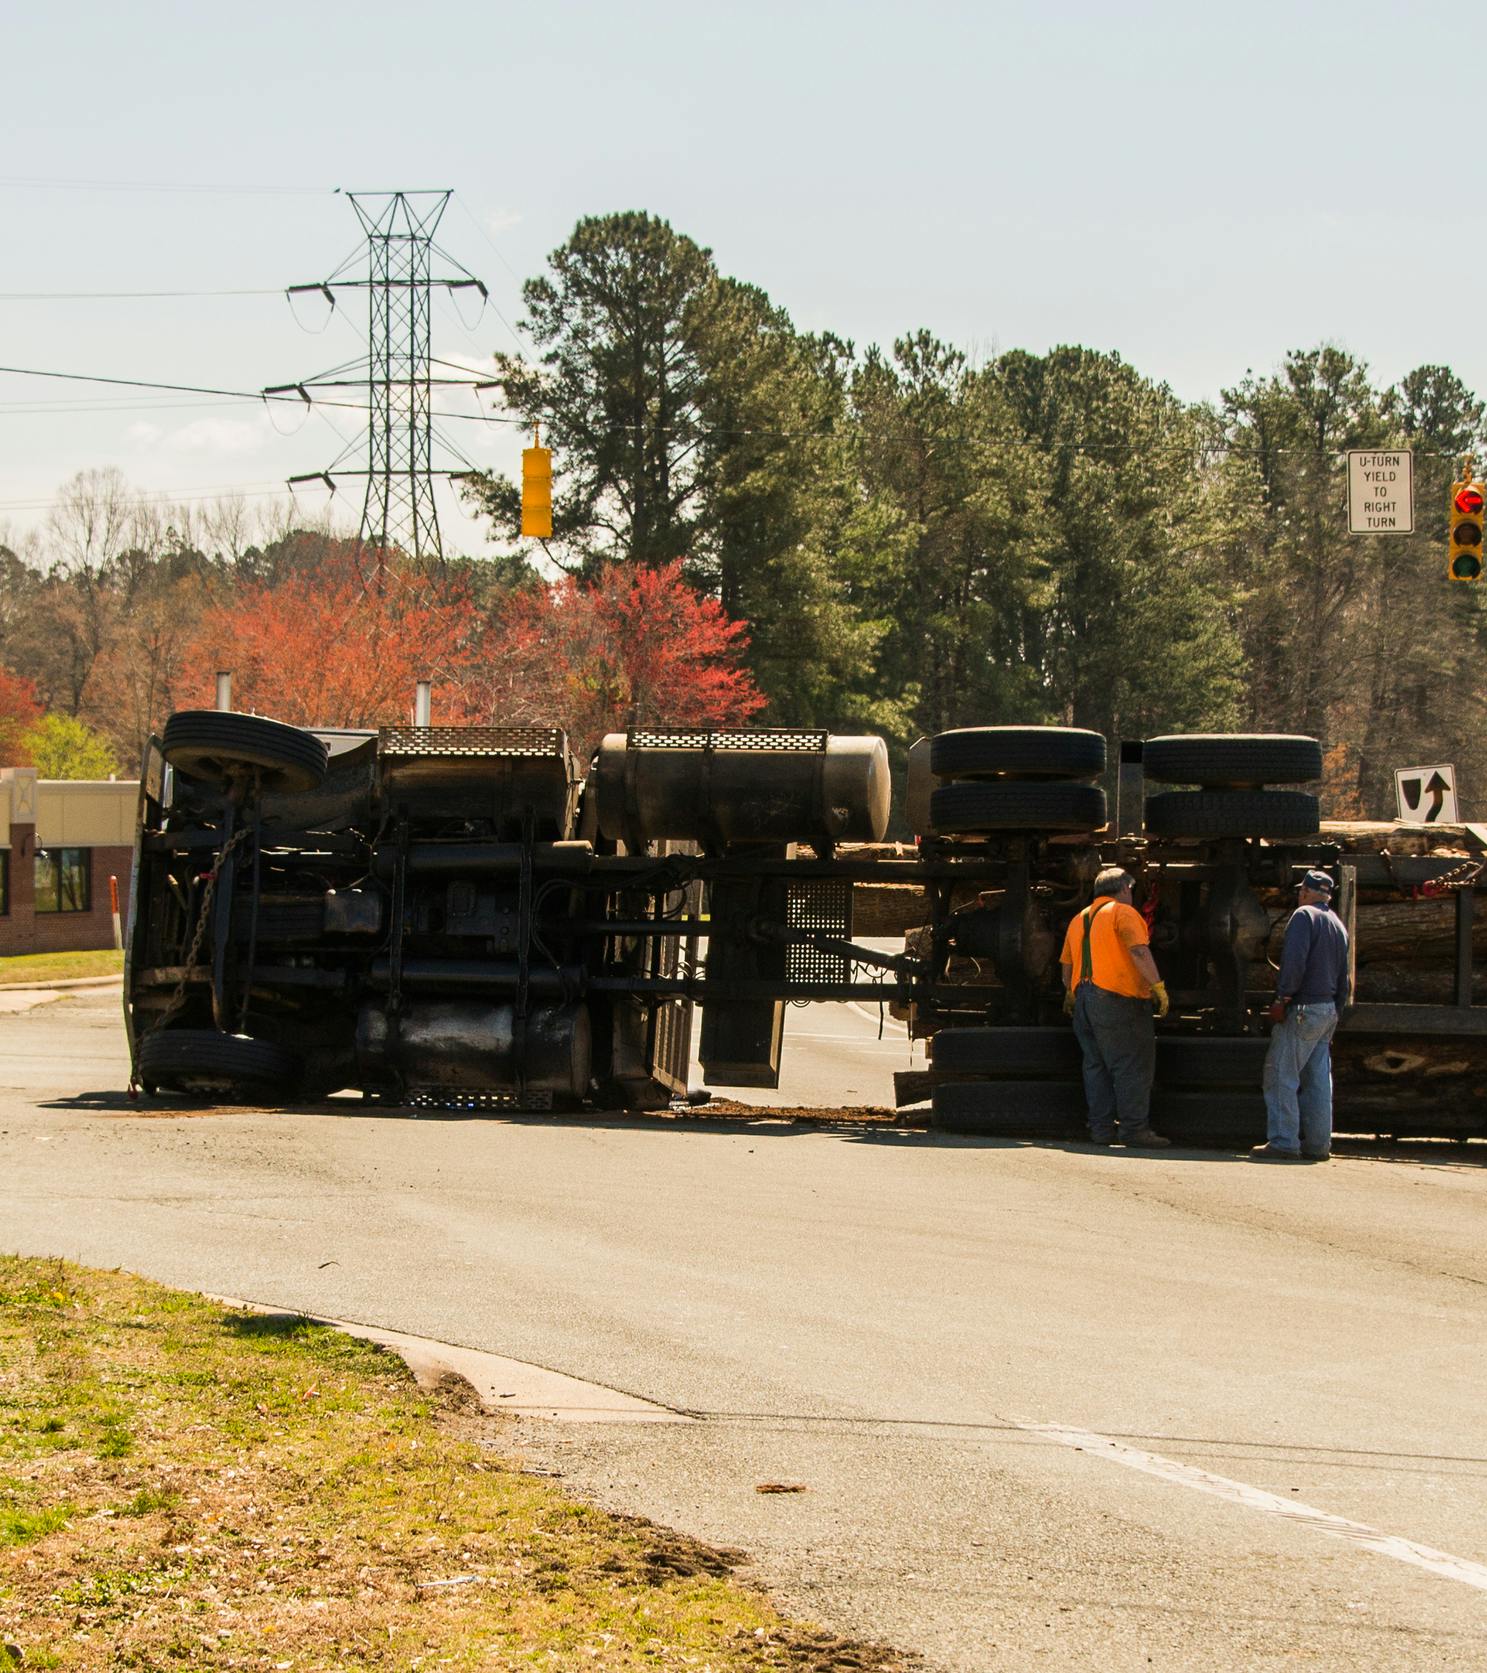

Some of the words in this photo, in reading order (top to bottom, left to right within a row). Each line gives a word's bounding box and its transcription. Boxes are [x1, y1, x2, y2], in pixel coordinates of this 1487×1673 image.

[1360, 456, 1400, 467] U-TURN
[1364, 471, 1396, 482] YIELD
[1374, 486, 1387, 497] TO
[1364, 502, 1397, 512] RIGHT
[1367, 517, 1396, 528] TURN
